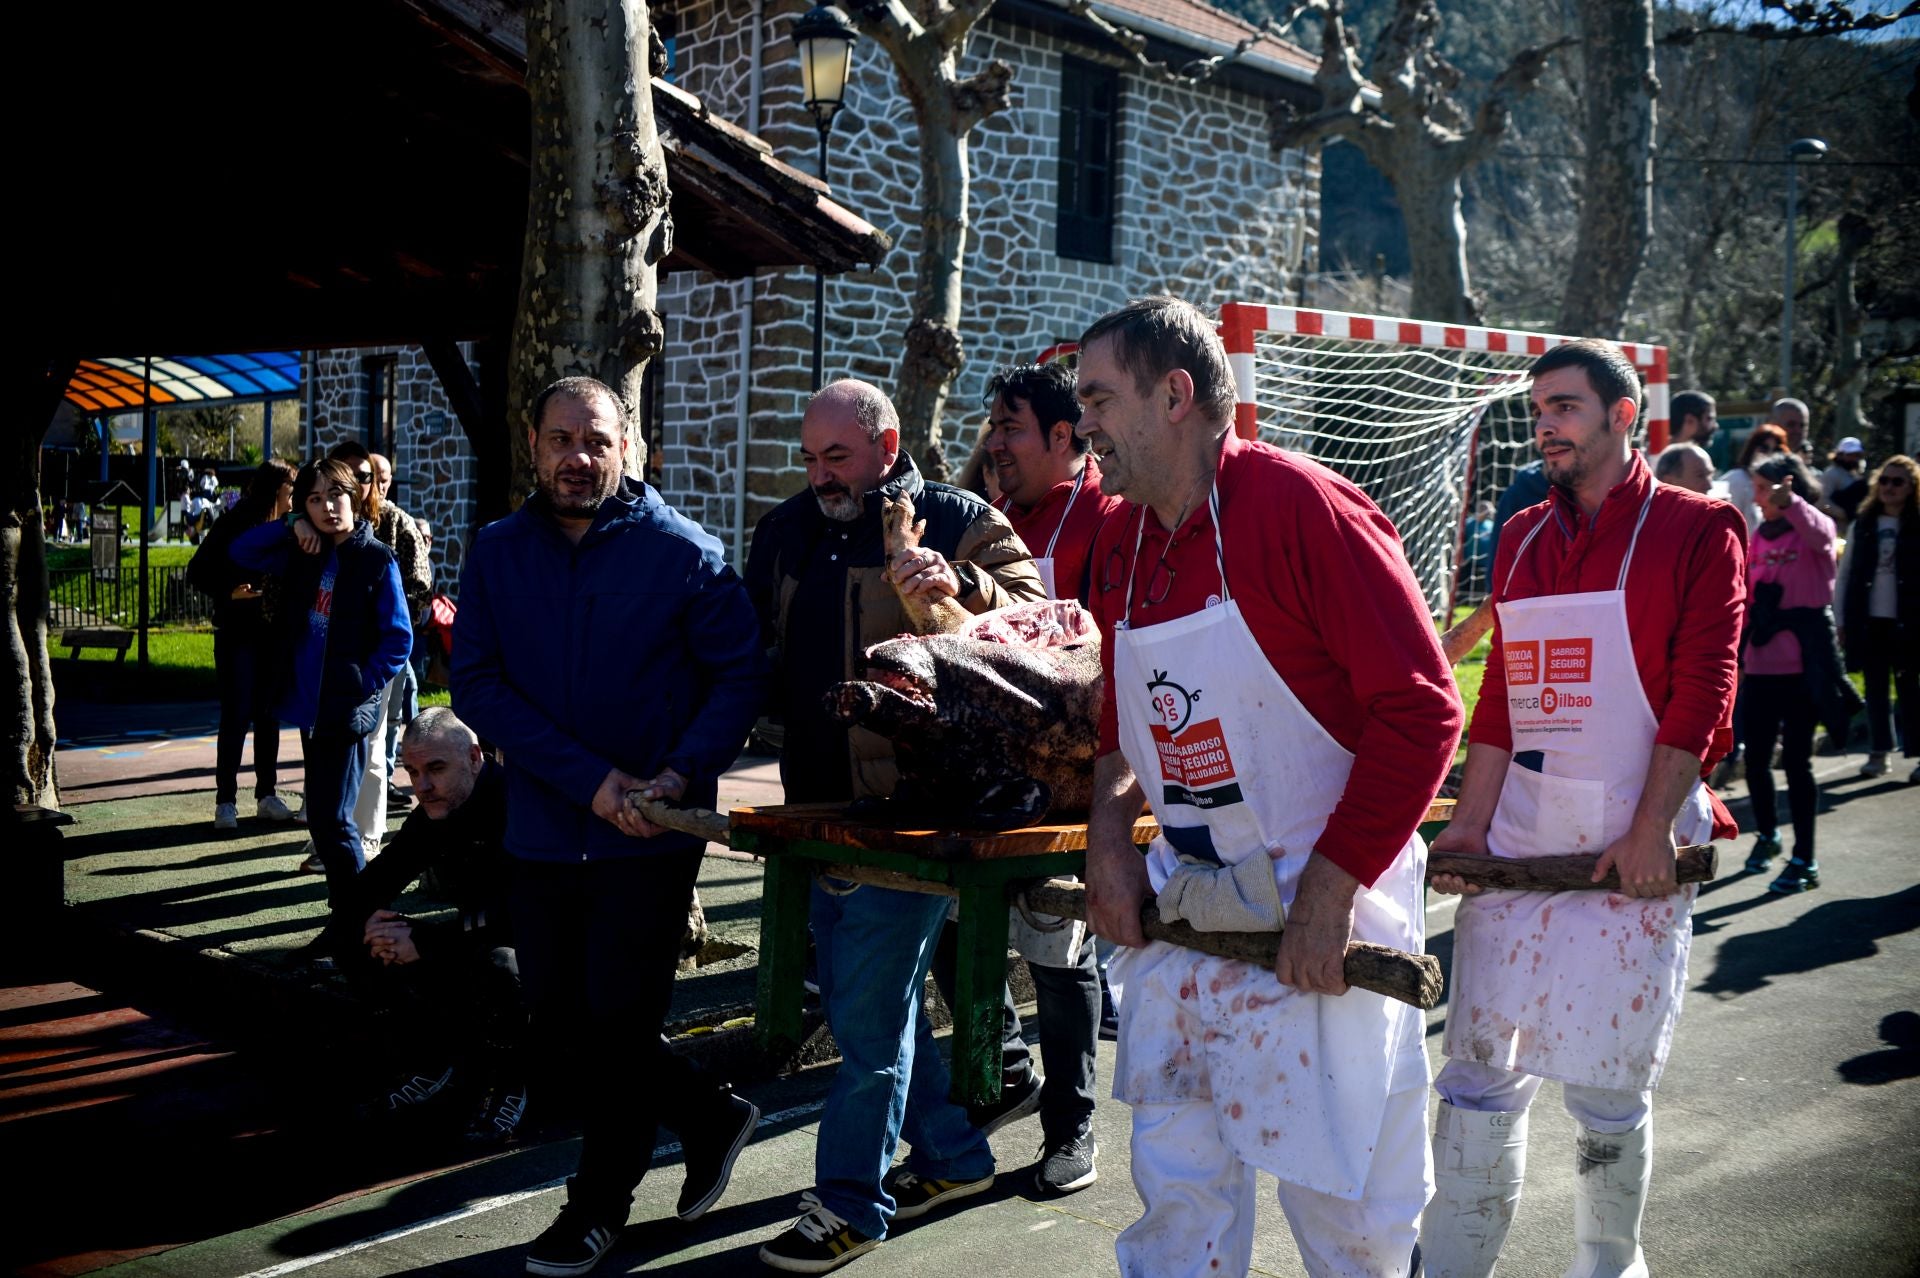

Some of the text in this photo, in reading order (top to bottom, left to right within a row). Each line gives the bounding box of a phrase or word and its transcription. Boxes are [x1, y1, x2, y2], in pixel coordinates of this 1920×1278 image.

[1551, 647, 1585, 656] SABROSO
[1550, 659, 1586, 669] SEGURO
[1549, 672, 1585, 680] SALUDABLE
[1177, 736, 1221, 757] SABROSO
[1181, 749, 1226, 770] SEGURO
